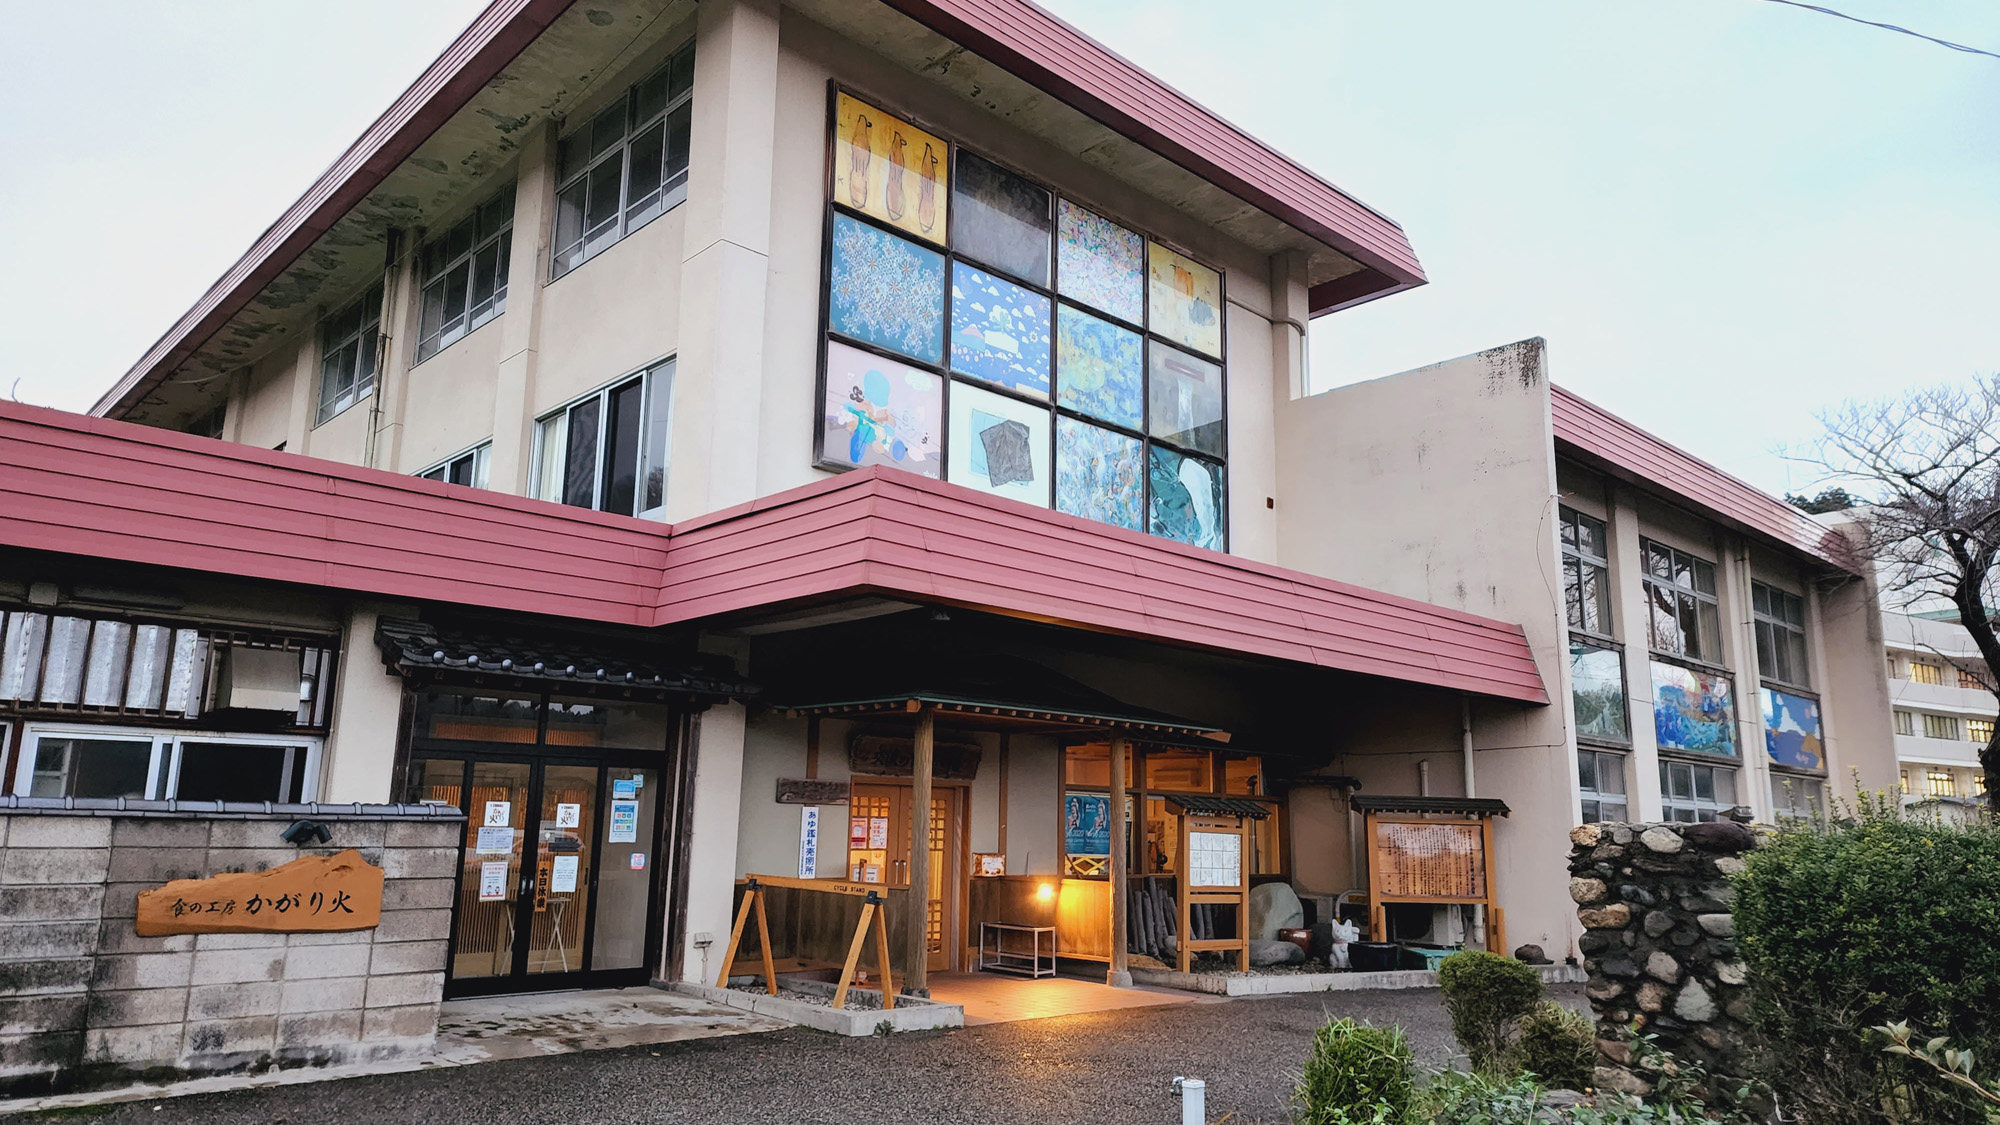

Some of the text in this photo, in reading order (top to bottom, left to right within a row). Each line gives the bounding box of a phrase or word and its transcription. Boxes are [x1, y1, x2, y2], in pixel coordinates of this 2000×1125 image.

[172, 890, 355, 918] 食の工房 かがり火
